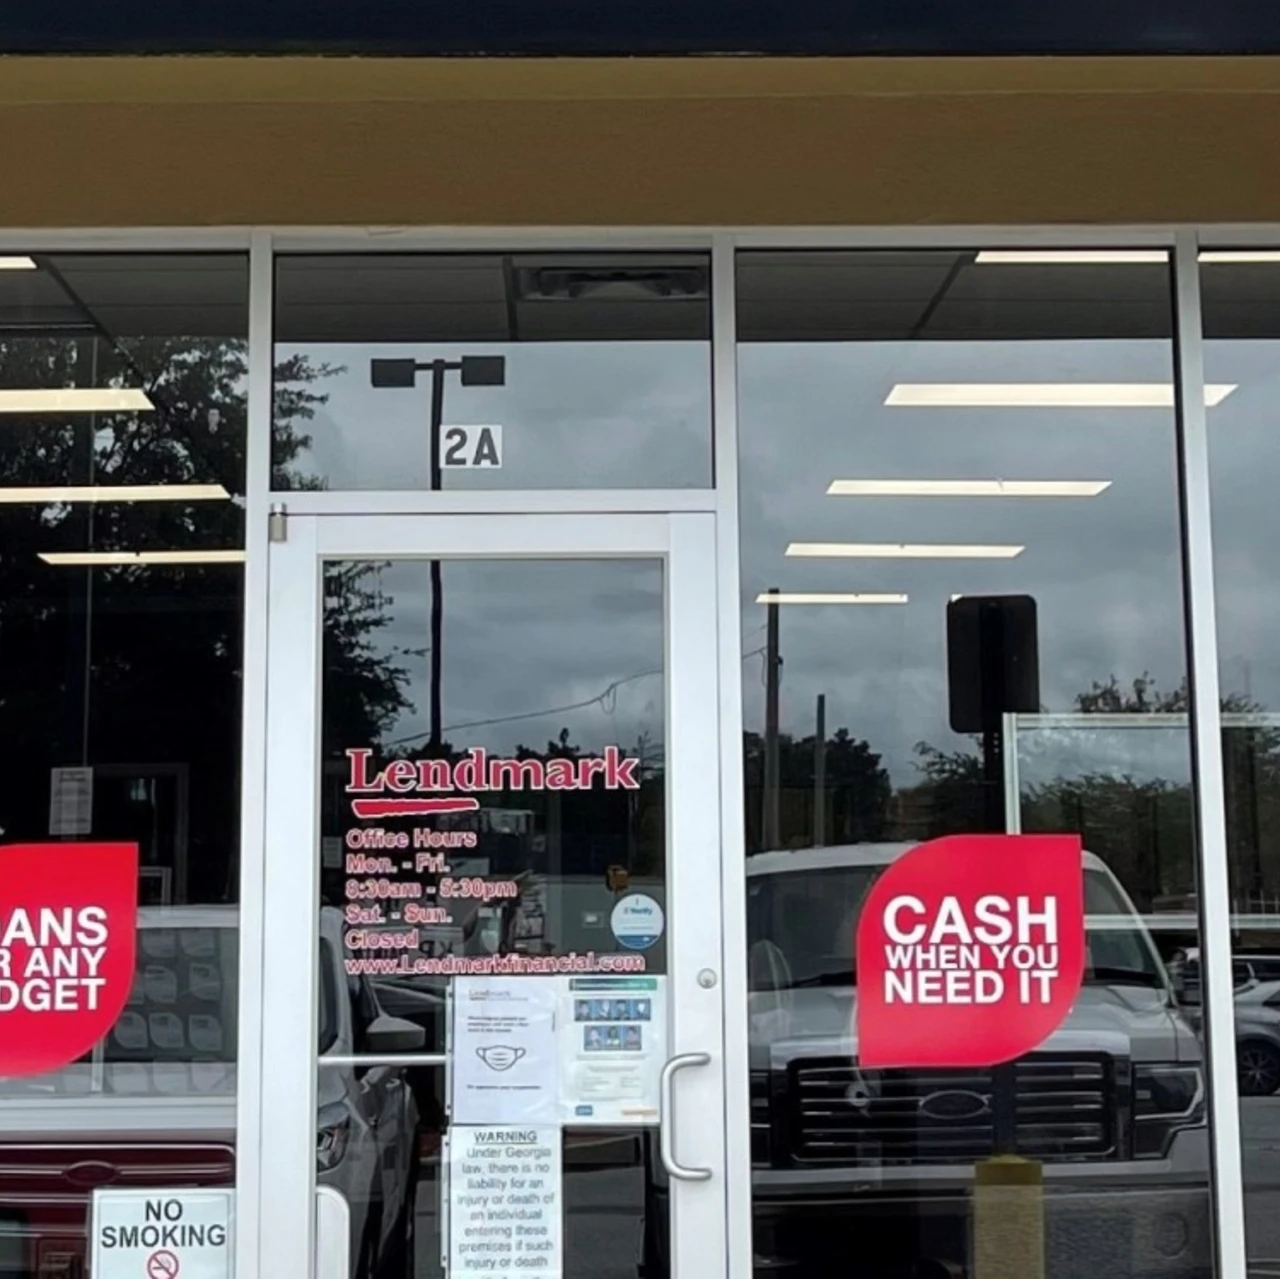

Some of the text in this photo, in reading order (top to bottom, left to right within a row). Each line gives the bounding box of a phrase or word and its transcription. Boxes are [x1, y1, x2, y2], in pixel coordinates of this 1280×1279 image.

[445, 427, 500, 465] 2A
[345, 746, 640, 792] Lendmark
[346, 828, 477, 848] Office Hours
[346, 853, 398, 873] Mon.
[415, 852, 451, 872] Fri.
[345, 878, 422, 899] 8:30am
[439, 877, 518, 902] 5:30pm
[346, 903, 386, 924] Sat.
[404, 903, 453, 923] Sun.
[883, 895, 1058, 944] CASH
[345, 929, 419, 949] Closed
[23, 947, 107, 978] ANY
[344, 951, 646, 974] www.Lendmarkfinancial.com
[884, 944, 1058, 970] WHEN YOU
[884, 970, 1059, 1004] NEED IT
[474, 1130, 537, 1142] WARNING
[466, 1147, 552, 1160] Under Georgia
[488, 1163, 519, 1174] there
[521, 1164, 531, 1173] is
[535, 1164, 550, 1173] no
[467, 1178, 544, 1191] liability for an
[145, 1199, 183, 1222] NO
[457, 1193, 555, 1207] injury or death of
[470, 1209, 542, 1220] an individual
[101, 1224, 226, 1248] SMOKING
[464, 1224, 548, 1238] entering these
[459, 1240, 553, 1254] premises if such
[464, 1256, 548, 1270] injury or death
